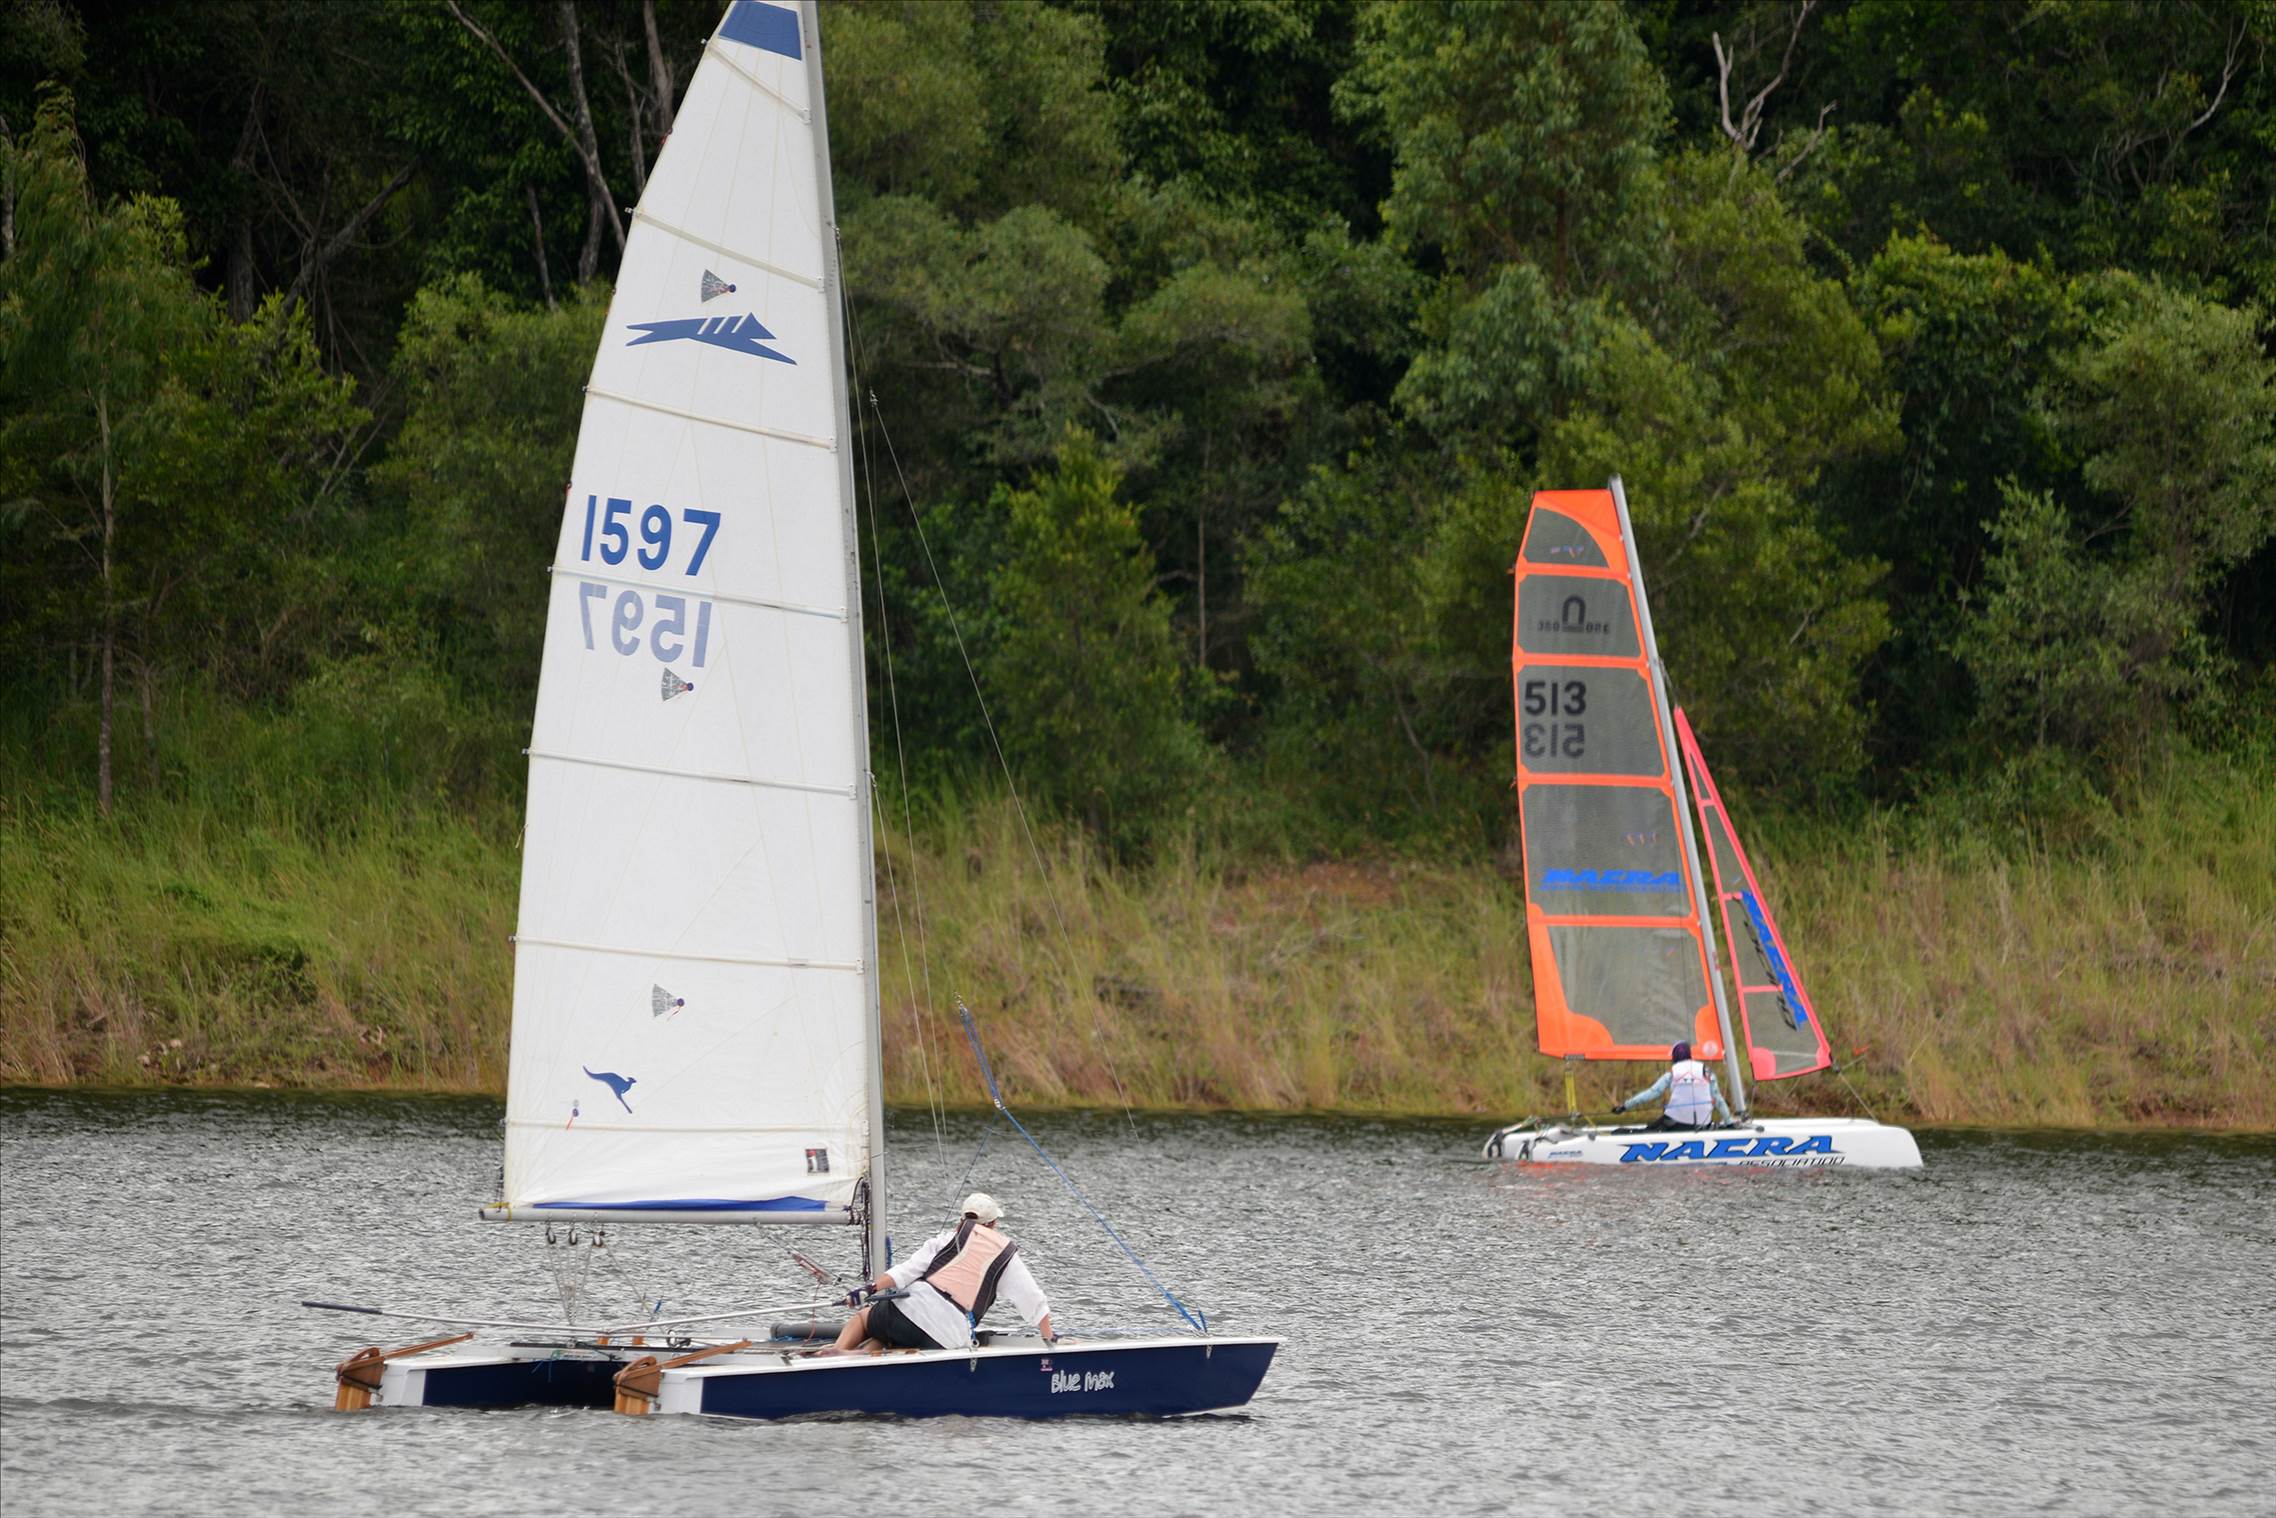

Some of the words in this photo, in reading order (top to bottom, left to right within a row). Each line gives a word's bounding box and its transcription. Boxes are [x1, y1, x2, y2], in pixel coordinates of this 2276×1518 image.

[581, 494, 721, 577] 1597
[1524, 680, 1587, 717] 513
[1618, 1135, 1842, 1162] NACRA
[1051, 1369, 1081, 1394] Blue
